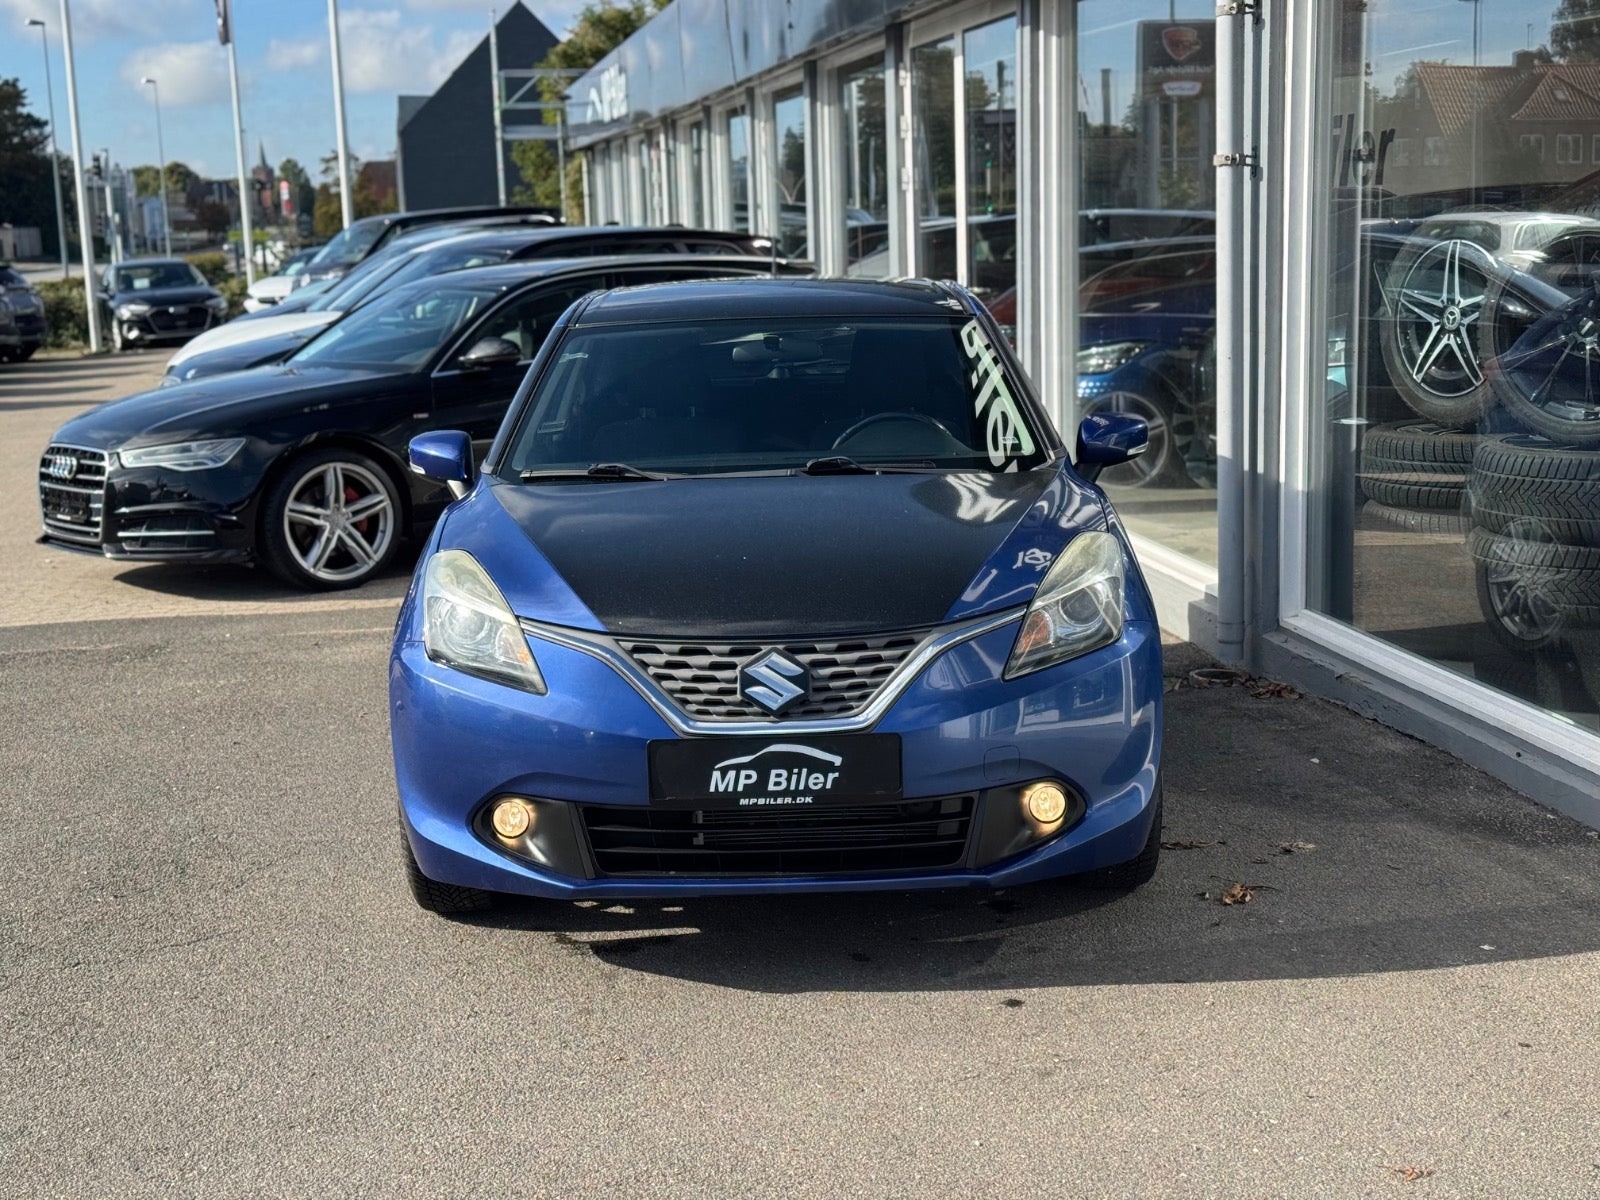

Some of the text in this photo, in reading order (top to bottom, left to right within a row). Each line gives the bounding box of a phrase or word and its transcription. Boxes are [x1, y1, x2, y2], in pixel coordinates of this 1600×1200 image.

[709, 767, 840, 792] MP Biler
[739, 796, 814, 806] MPBILER.DK
